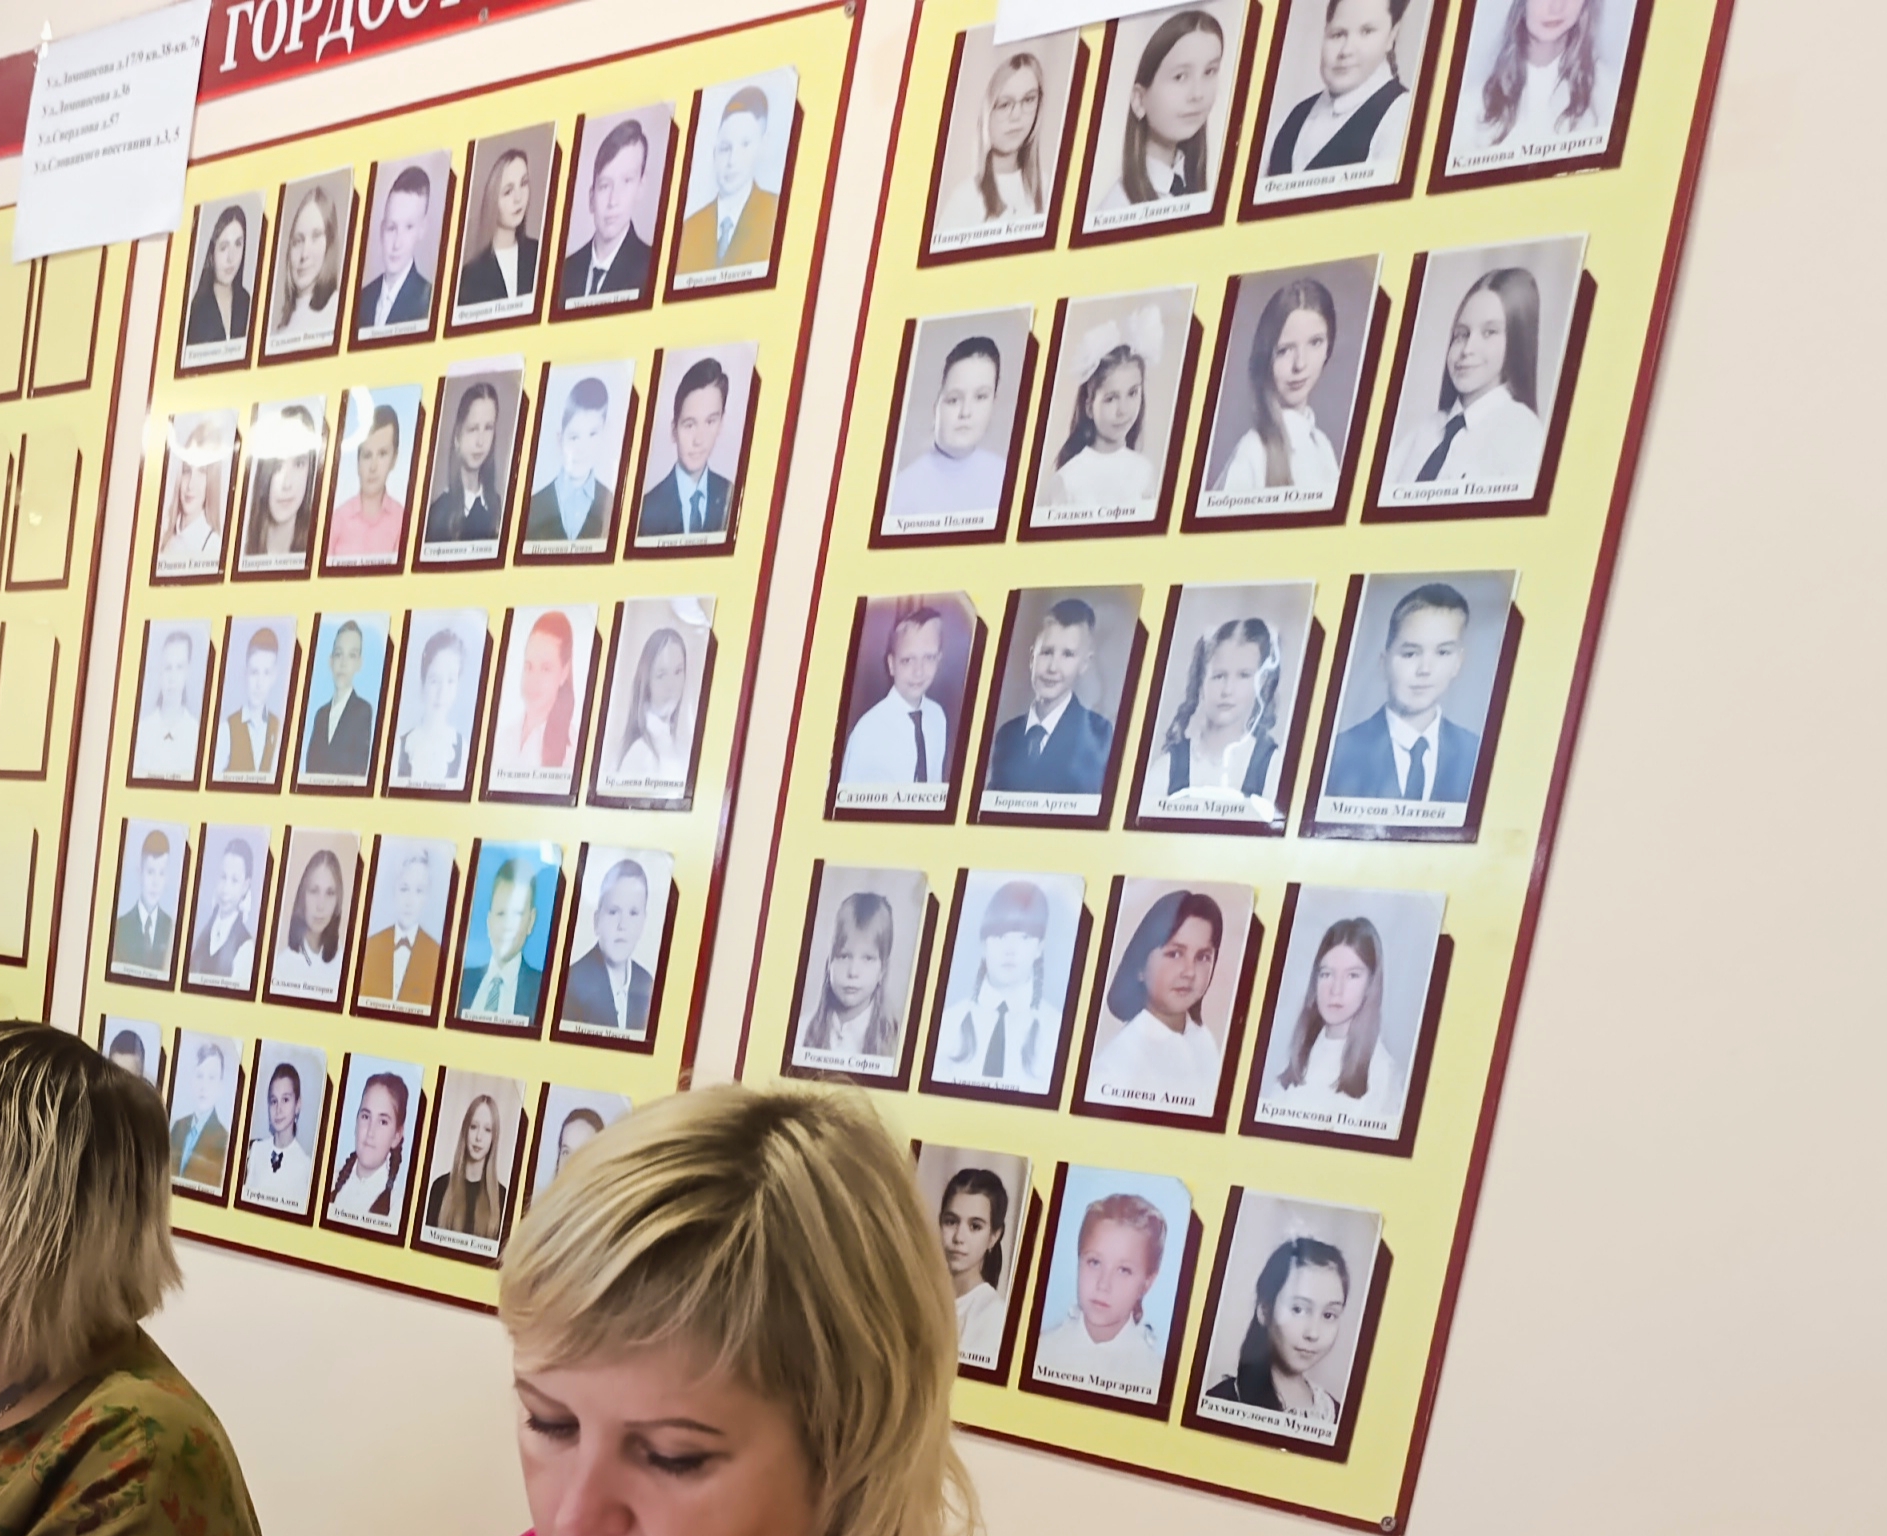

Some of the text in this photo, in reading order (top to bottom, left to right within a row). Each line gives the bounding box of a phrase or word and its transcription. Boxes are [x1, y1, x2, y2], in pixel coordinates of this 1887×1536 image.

[219, 0, 462, 73] ГОРД
[1520, 135, 1603, 158] Маргарита
[1004, 221, 1045, 236] Ксения
[1393, 481, 1519, 501] Сидорова Полина
[1207, 490, 1323, 509] Бобровская Юлия
[944, 515, 984, 527] Полина
[1097, 506, 1136, 520] София
[837, 789, 946, 804] Сазонов Алексей
[994, 795, 1078, 811] Борисов Артем
[1158, 800, 1245, 816] Чехова Мария
[1393, 805, 1446, 819] Матвей
[848, 1057, 880, 1070] София
[1160, 1092, 1196, 1107] Анна
[1337, 1112, 1387, 1130] Полина
[959, 1351, 991, 1363] олина
[1037, 1365, 1152, 1396] Михеева Маргарита
[1283, 1418, 1332, 1439] Мунира
